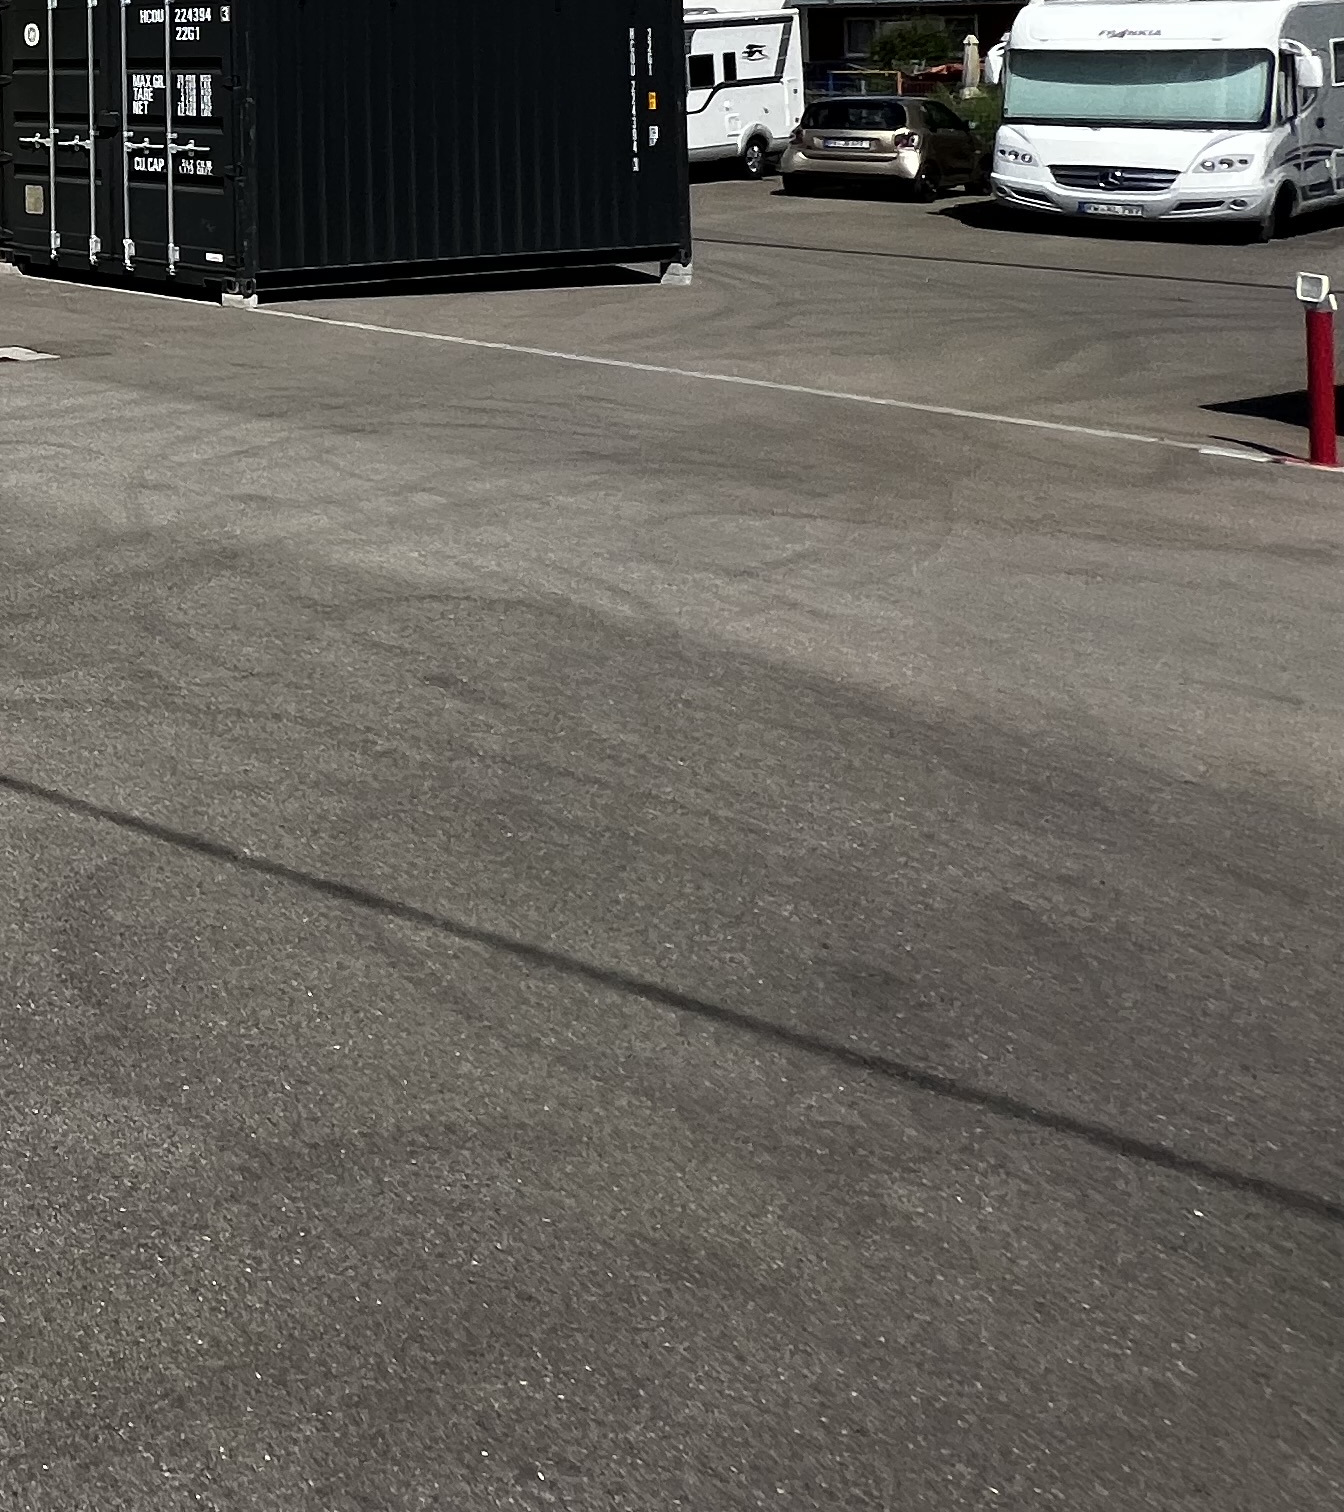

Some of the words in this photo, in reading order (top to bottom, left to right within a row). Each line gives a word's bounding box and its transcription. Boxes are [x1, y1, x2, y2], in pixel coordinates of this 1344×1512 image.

[174, 8, 212, 23] 224394
[220, 6, 231, 22] 3
[175, 27, 201, 41] 22G1
[133, 88, 154, 102] TARE
[132, 101, 149, 115] NET
